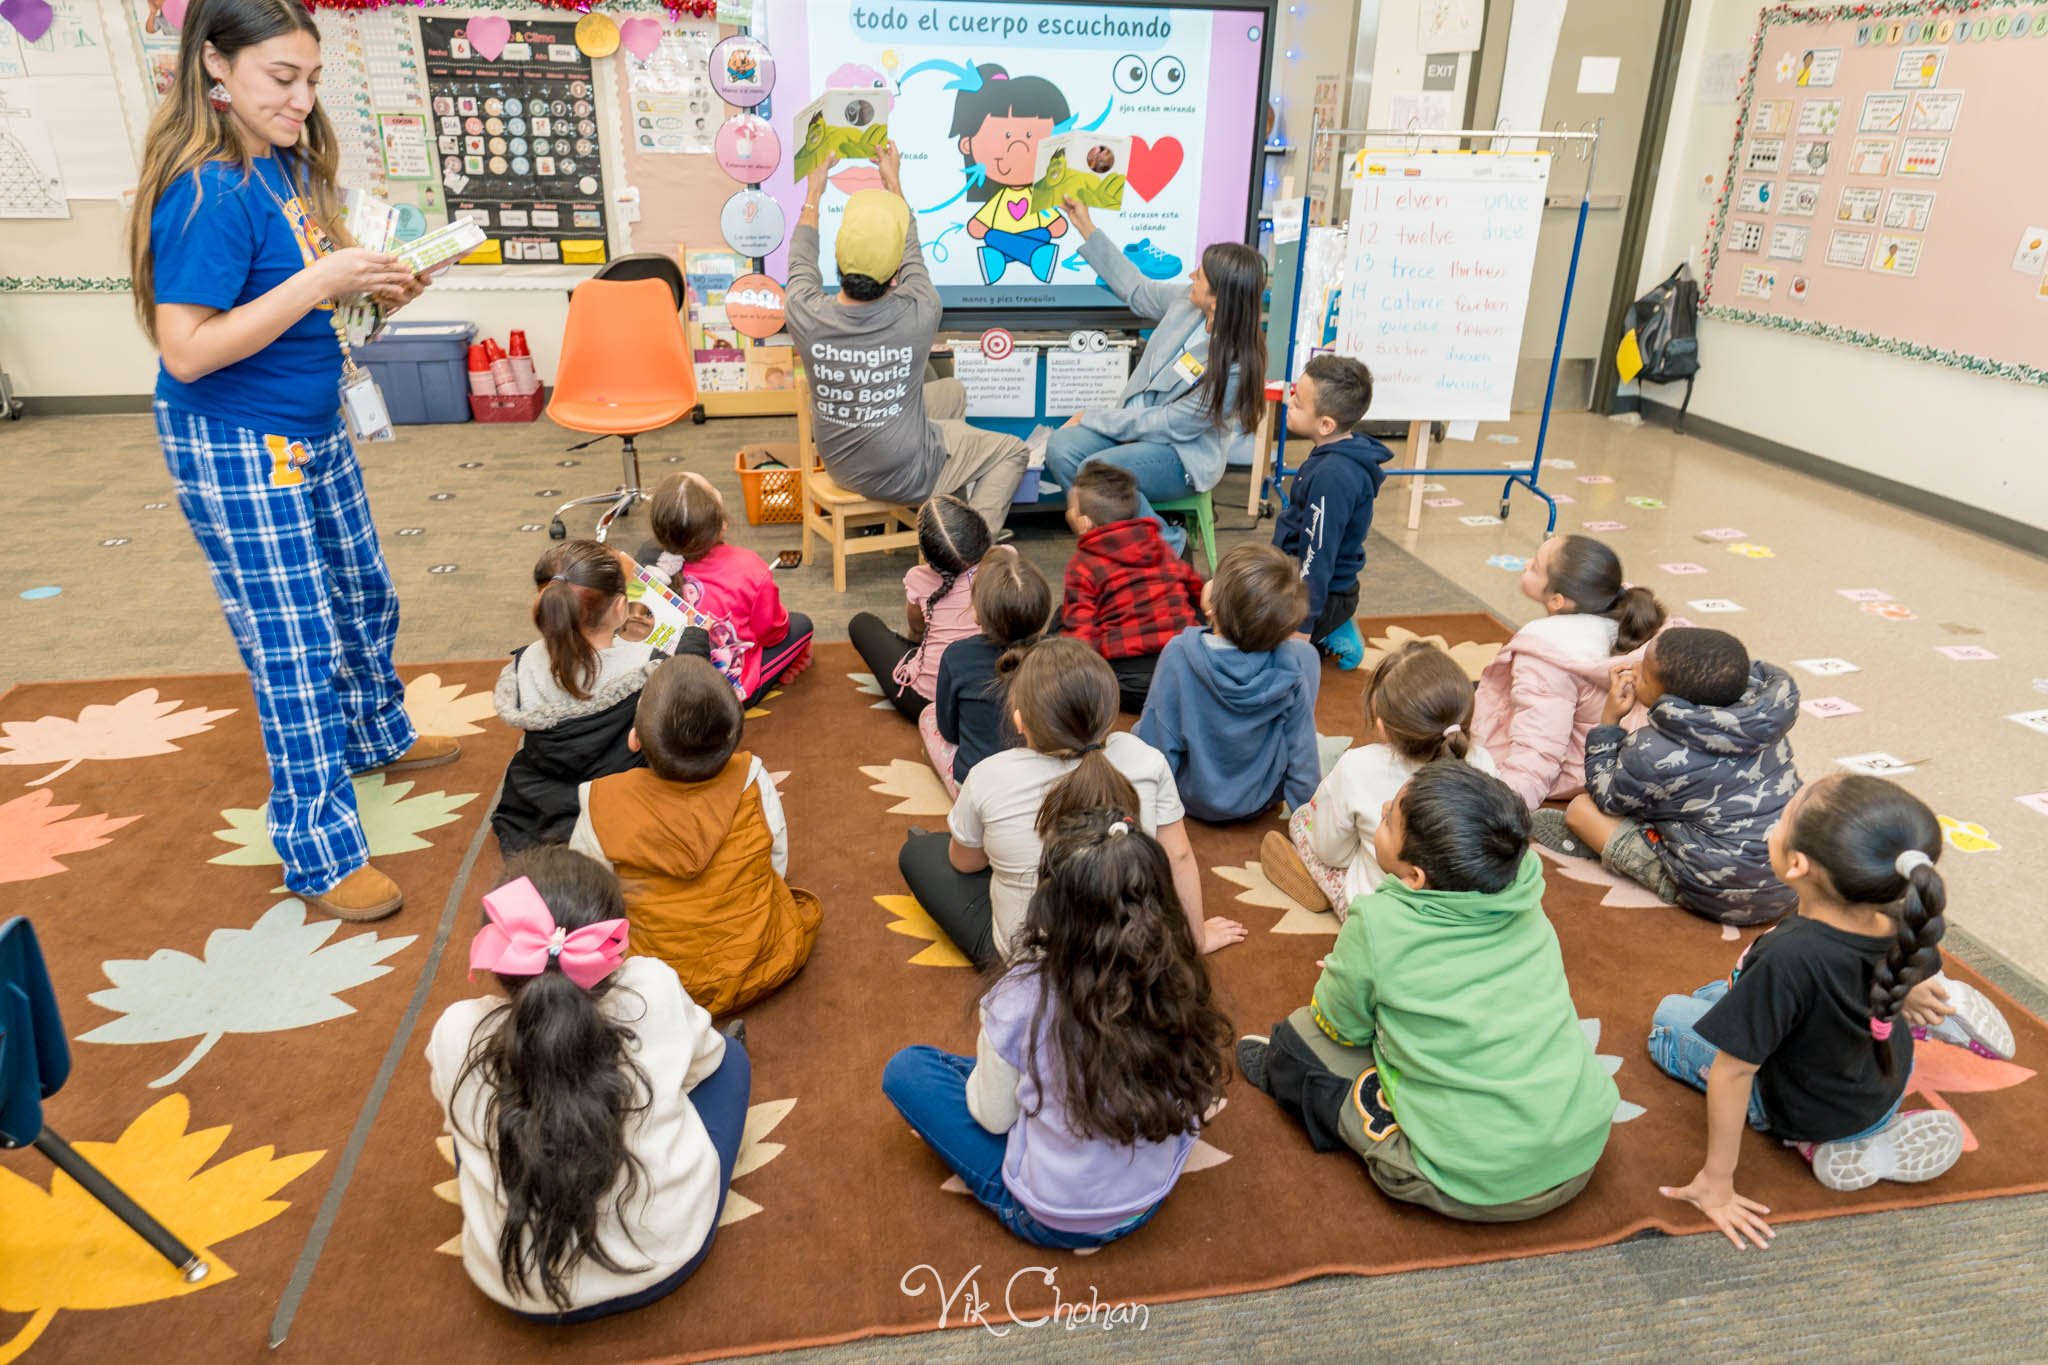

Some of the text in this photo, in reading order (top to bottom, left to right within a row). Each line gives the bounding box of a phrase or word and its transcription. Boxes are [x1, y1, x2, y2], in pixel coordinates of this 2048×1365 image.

[853, 6, 1171, 39] todo el cuerpo escuchando
[524, 32, 556, 44] Clima
[457, 44, 464, 54] 6
[1428, 64, 1455, 78] EXIT
[1364, 186, 1380, 212] 11
[1396, 188, 1448, 209] elven
[1759, 182, 1770, 204] 6
[1359, 223, 1378, 246] 12
[1395, 221, 1455, 245] twelve
[1355, 253, 1375, 273] 13
[1392, 256, 1434, 279] trece
[997, 296, 1013, 304] pies
[1016, 296, 1056, 304] tranquilos
[1352, 282, 1511, 312] 14 catorce fourteen
[1346, 332, 1363, 352] 16
[811, 343, 913, 368] Changing
[812, 364, 911, 384] the World
[816, 383, 908, 402] One Book
[816, 401, 835, 416] at
[838, 406, 850, 418] a
[854, 403, 904, 422] Time.
